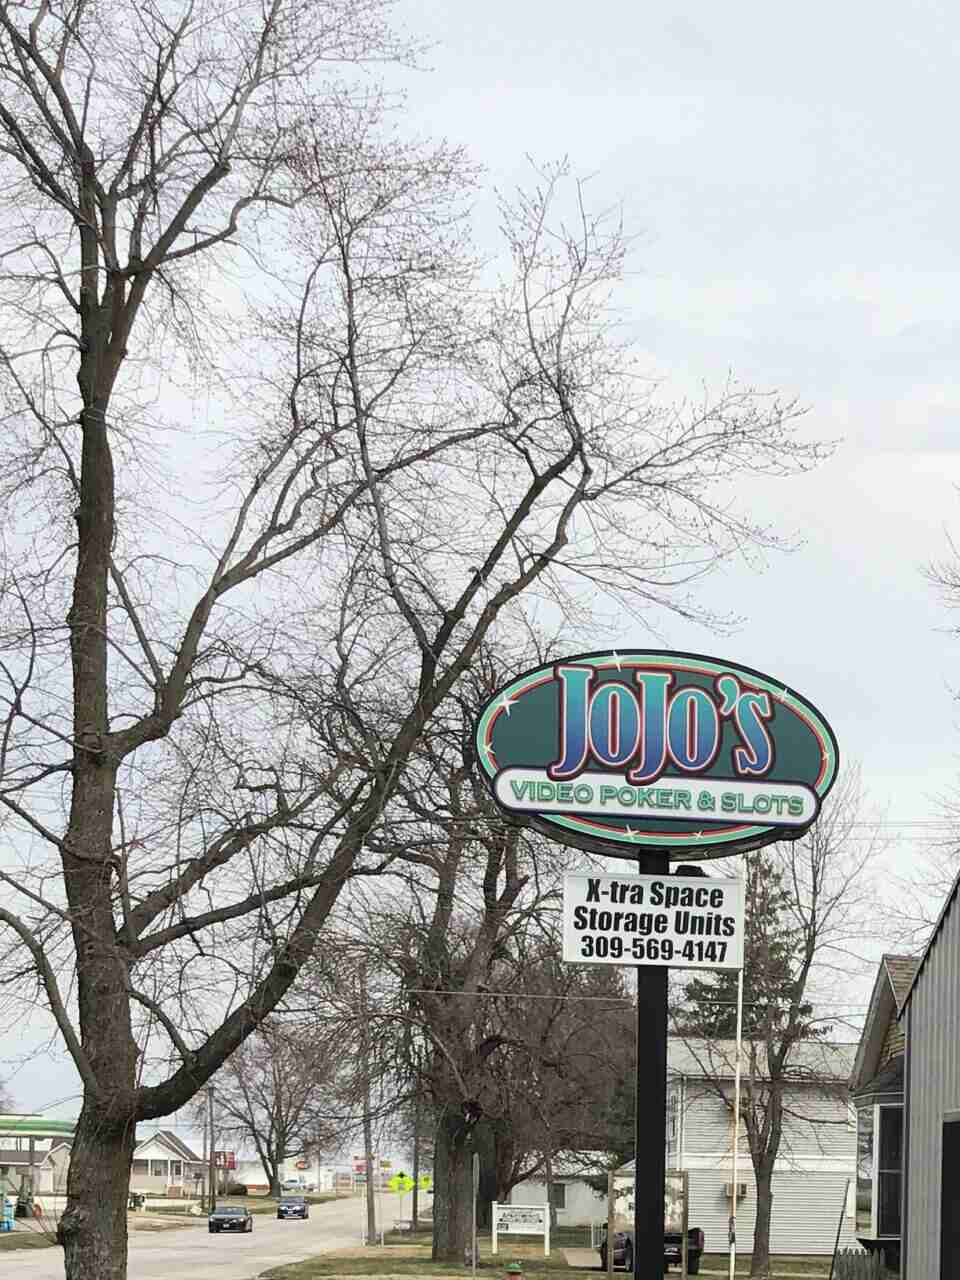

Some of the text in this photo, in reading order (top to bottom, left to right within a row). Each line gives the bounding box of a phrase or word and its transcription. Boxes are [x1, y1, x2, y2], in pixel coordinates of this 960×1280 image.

[510, 779, 804, 816] VIDEO POKER & SLOTS
[585, 878, 724, 909] X-tra Space
[573, 905, 736, 937] Storage Units
[580, 935, 728, 963] 309-569-4147
